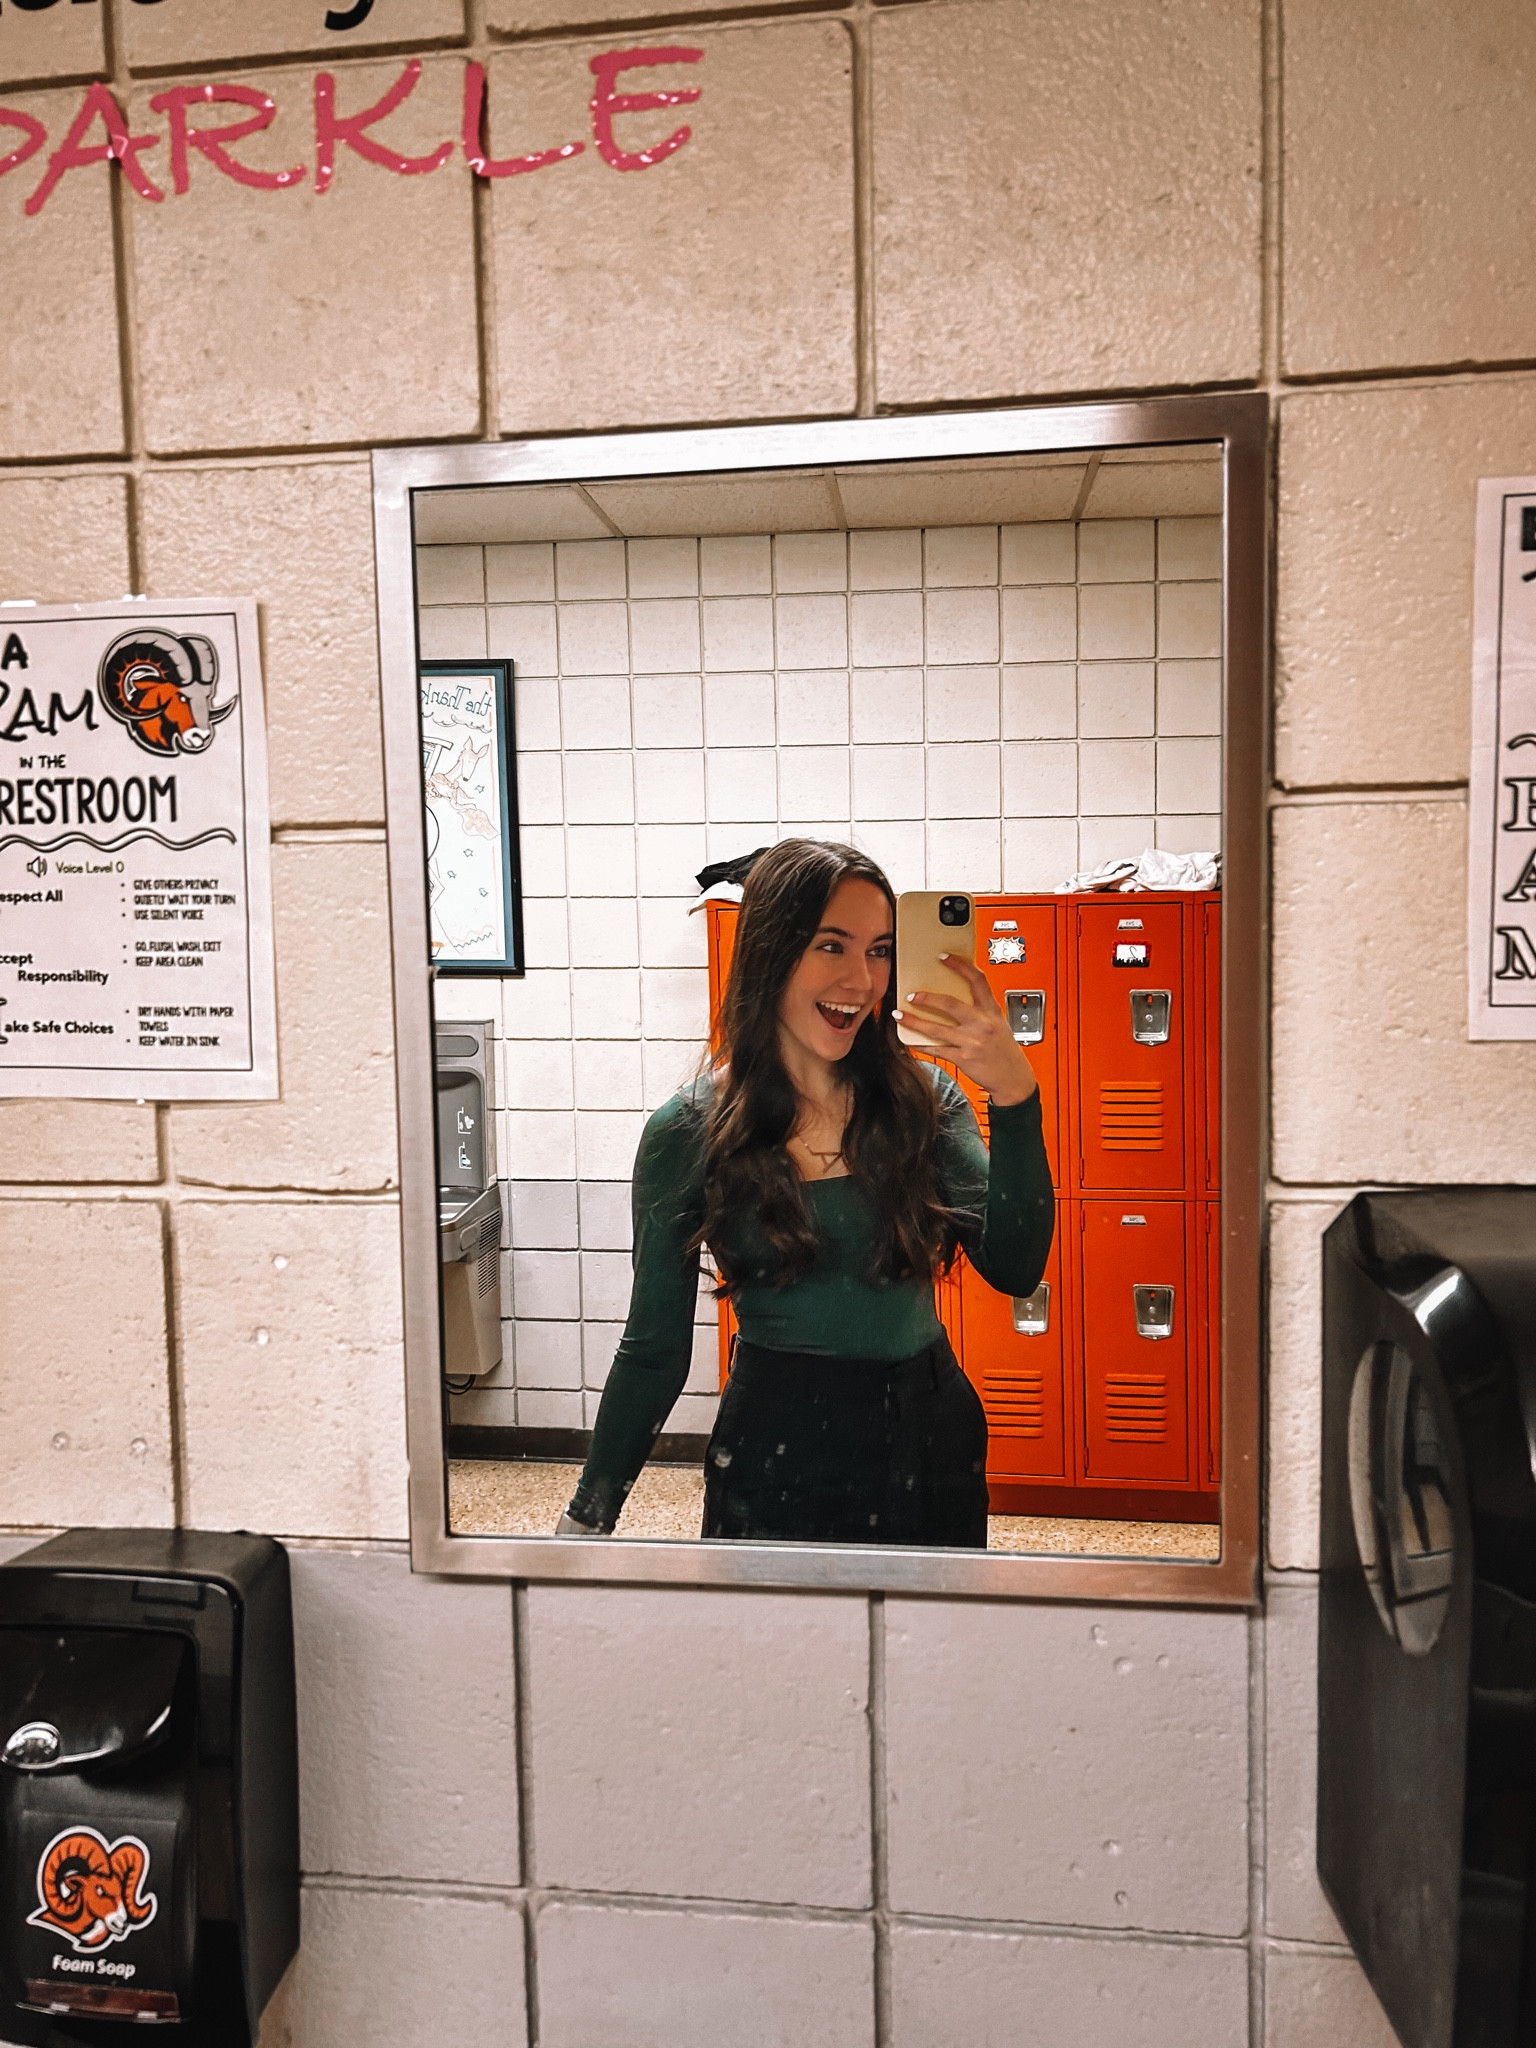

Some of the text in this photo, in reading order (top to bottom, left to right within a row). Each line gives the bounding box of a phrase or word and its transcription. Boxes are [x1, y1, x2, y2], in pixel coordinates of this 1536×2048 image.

[1, 632, 28, 671] A
[19, 754, 66, 769] IN THE
[0, 775, 177, 825] RESTROOM
[56, 861, 84, 874] Voice
[86, 861, 113, 874] Level
[134, 879, 219, 890] GIVE OTHERS PRIVACY
[45, 889, 63, 902] All
[134, 894, 236, 905] QUIETLY WAIT YOUR TURN
[134, 909, 204, 920] USE SILENT VOICE
[0, 953, 33, 967] cept
[135, 956, 204, 967] KEEP AREA CLEAN
[17, 969, 109, 985] Responsibility
[138, 1006, 234, 1018] DRY HANDS WITH PAPER
[33, 1020, 61, 1034] Safe
[64, 1021, 114, 1035] Choices
[139, 1021, 169, 1032] TOWELS
[139, 1036, 220, 1047] KEEP WATER IN SINK
[52, 1954, 136, 1980] Foam Soap
